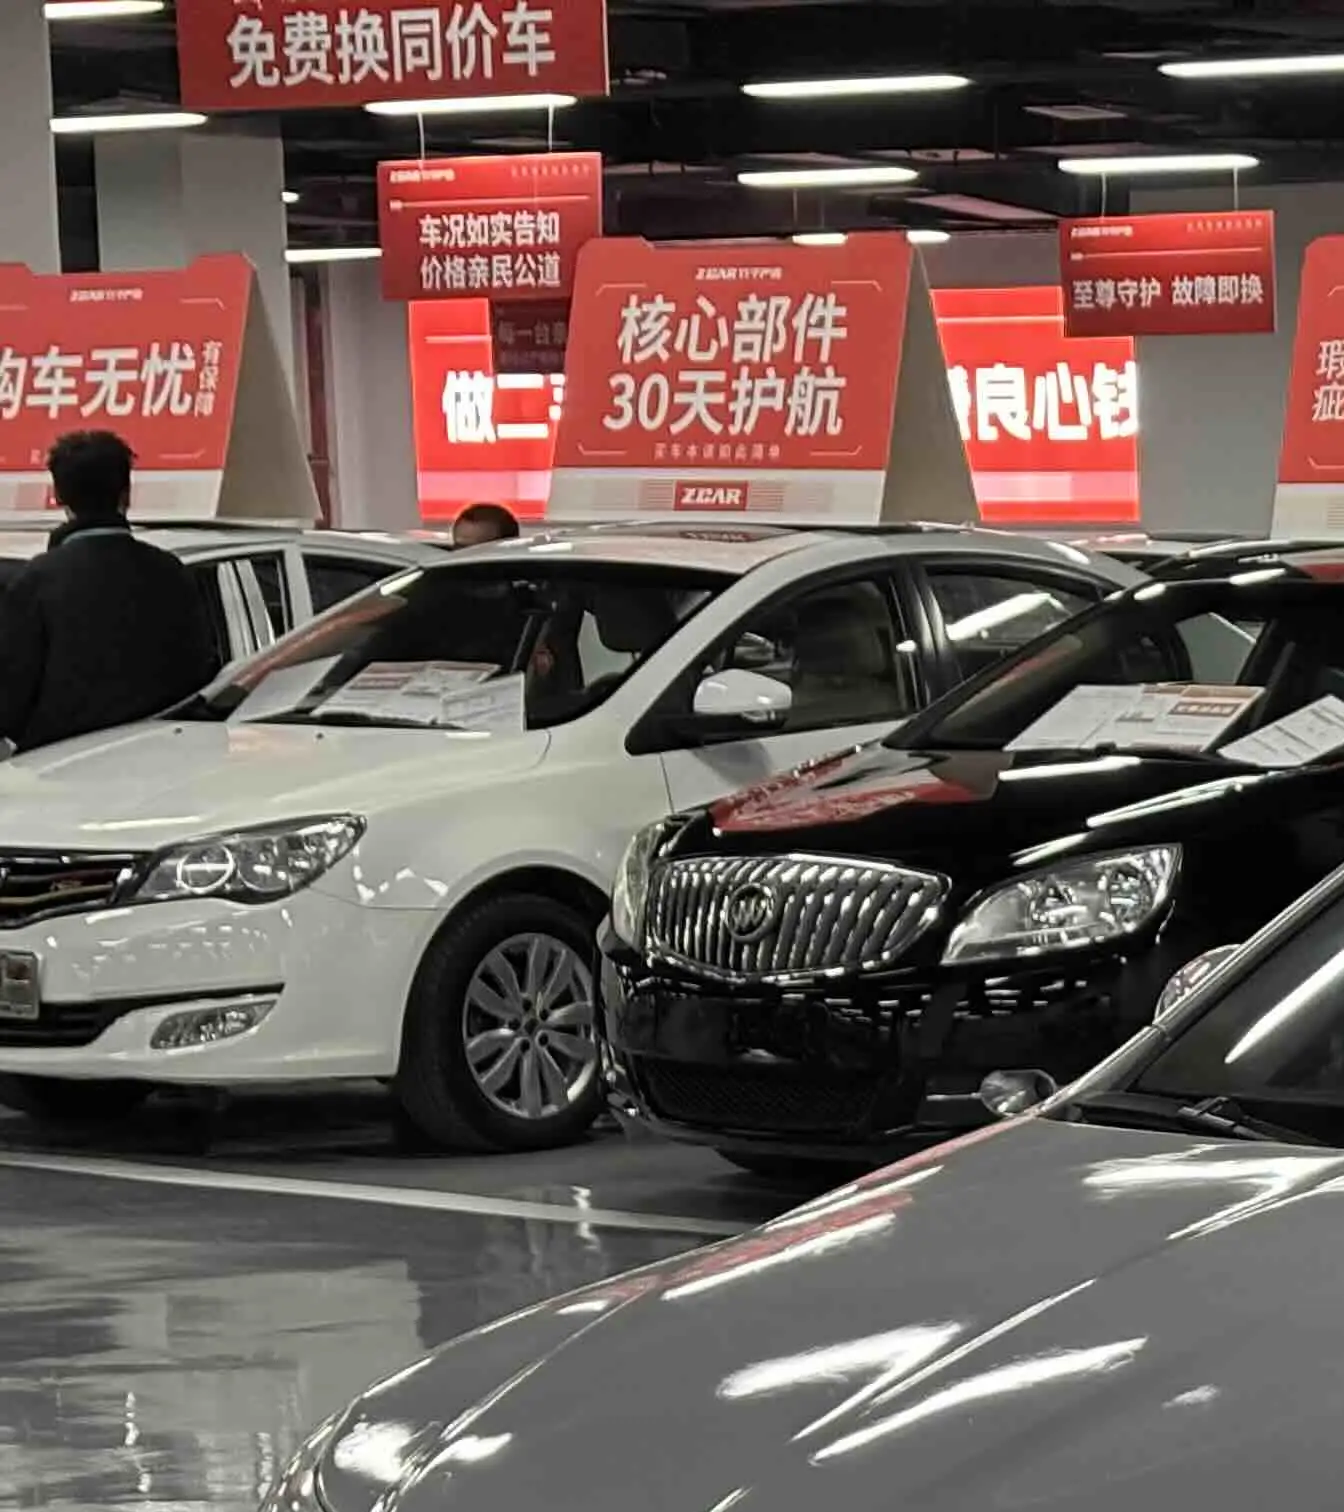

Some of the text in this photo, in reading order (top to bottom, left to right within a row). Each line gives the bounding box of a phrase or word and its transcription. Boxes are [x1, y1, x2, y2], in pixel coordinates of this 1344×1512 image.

[226, 1, 556, 88] 免费换同价车
[419, 210, 560, 249] 车况如实告知
[420, 251, 561, 290] 价格亲民公道
[1073, 272, 1264, 309] 至尊守护 故障即换
[617, 292, 848, 365] 核心部件
[603, 366, 848, 438] 30天护航
[681, 487, 742, 505] ZCAR
